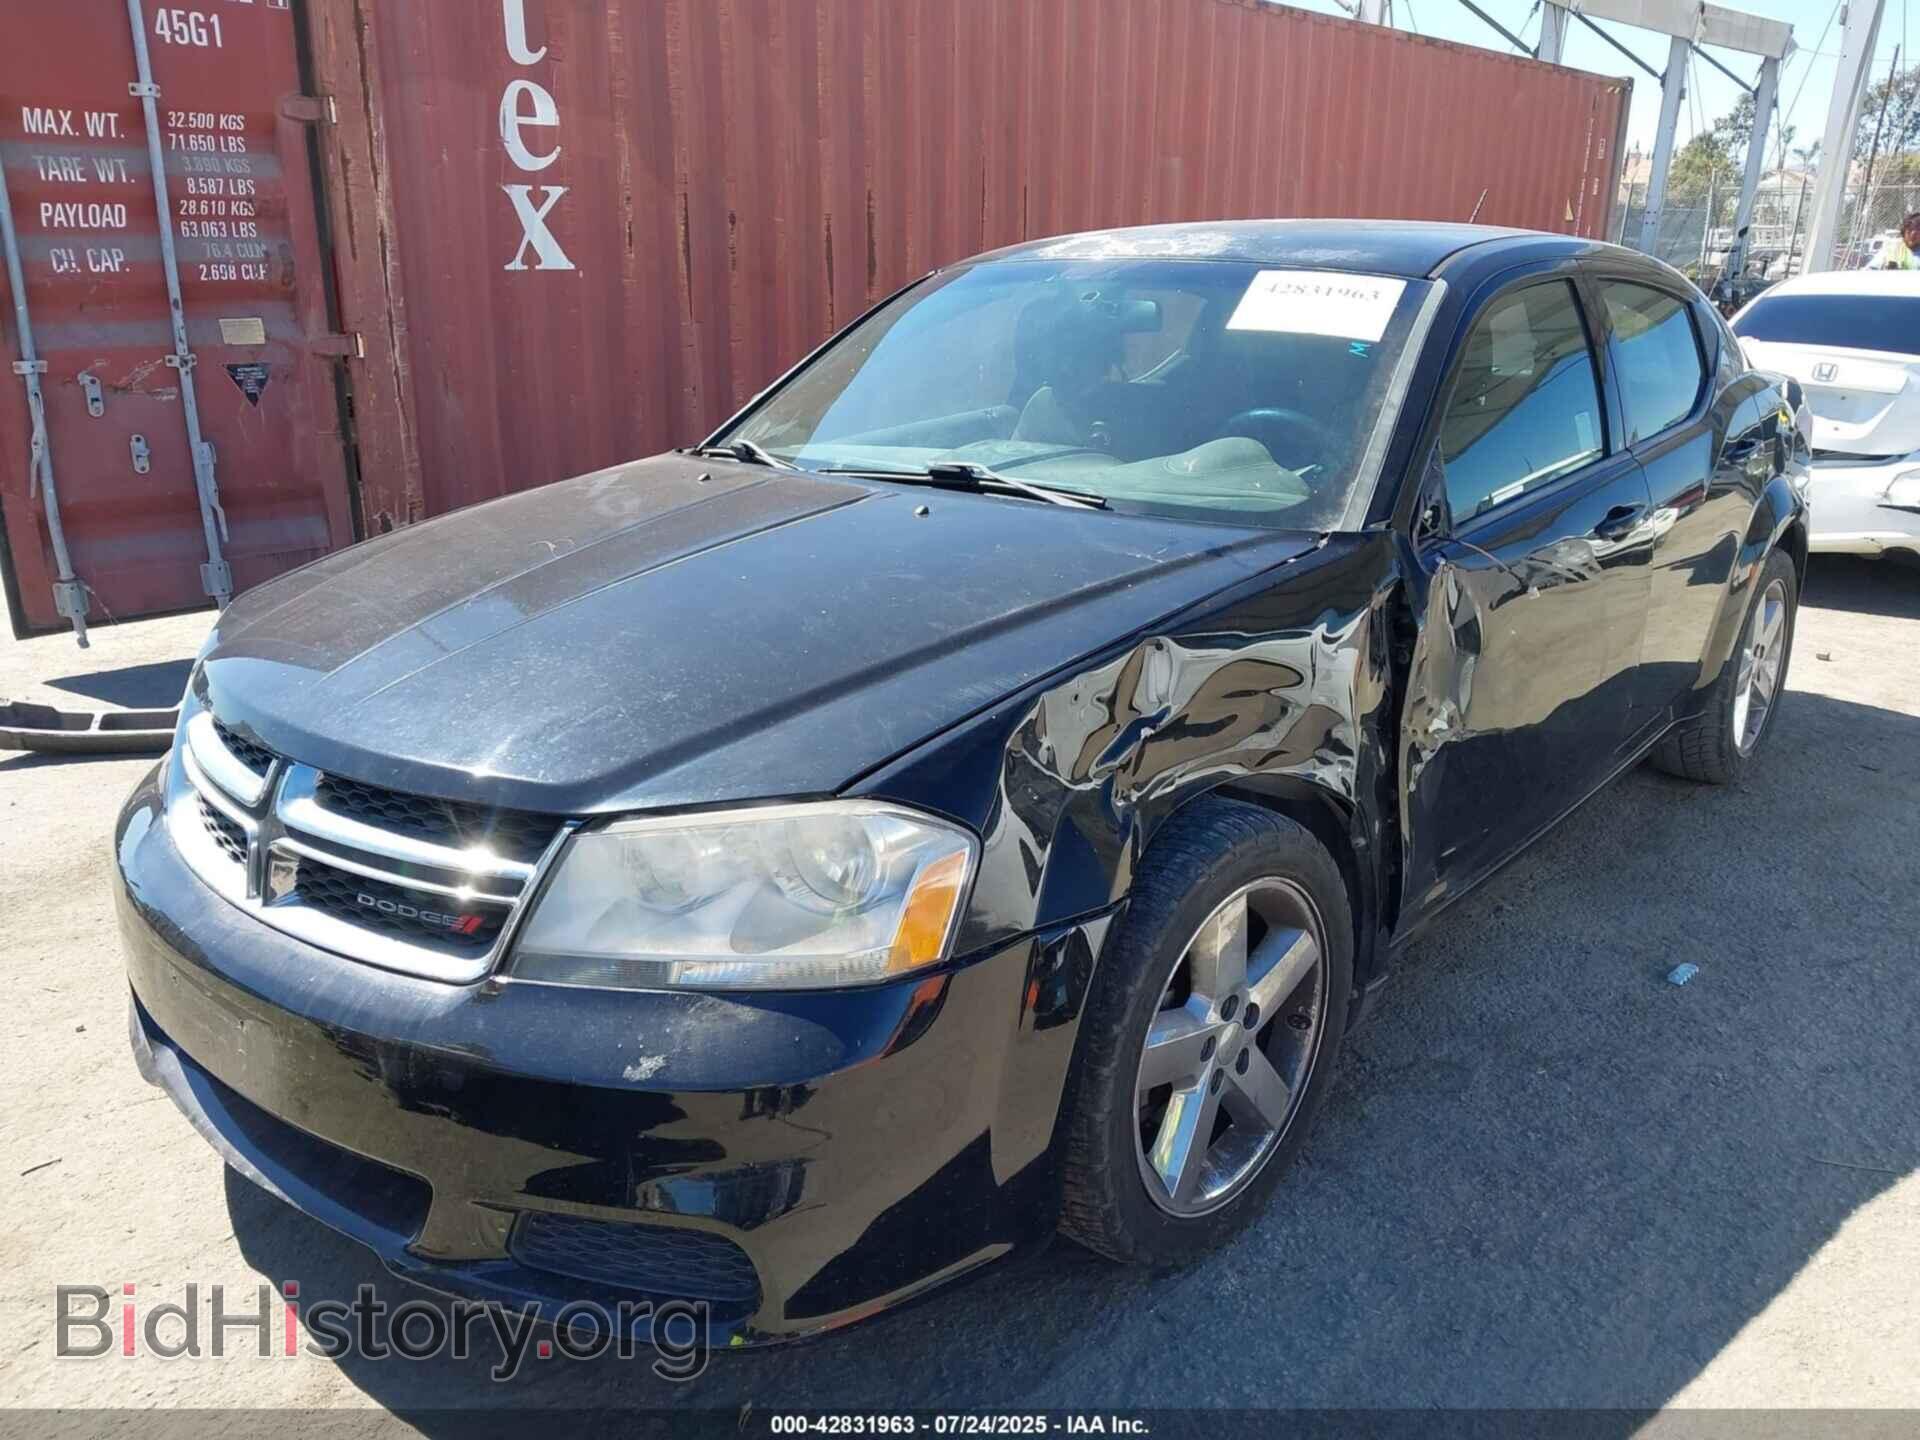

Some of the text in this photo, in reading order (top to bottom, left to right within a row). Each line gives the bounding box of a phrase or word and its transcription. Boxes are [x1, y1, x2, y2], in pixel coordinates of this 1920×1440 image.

[155, 8, 222, 47] 45G1
[22, 106, 124, 138] MAX. WT.
[168, 111, 245, 130] 32.500 KGS
[168, 133, 245, 152] 71.650 LBS
[32, 155, 135, 183] TARE WT.
[224, 158, 251, 174] KGS
[187, 177, 255, 196] 8.587 LBS
[40, 202, 126, 228] PAYLOAD
[180, 200, 255, 216] 28.610 KGS
[180, 221, 256, 238] 63.063 LBS
[86, 248, 130, 272] CAP.
[199, 264, 236, 281] 2.698
[357, 893, 465, 928] DODGE
